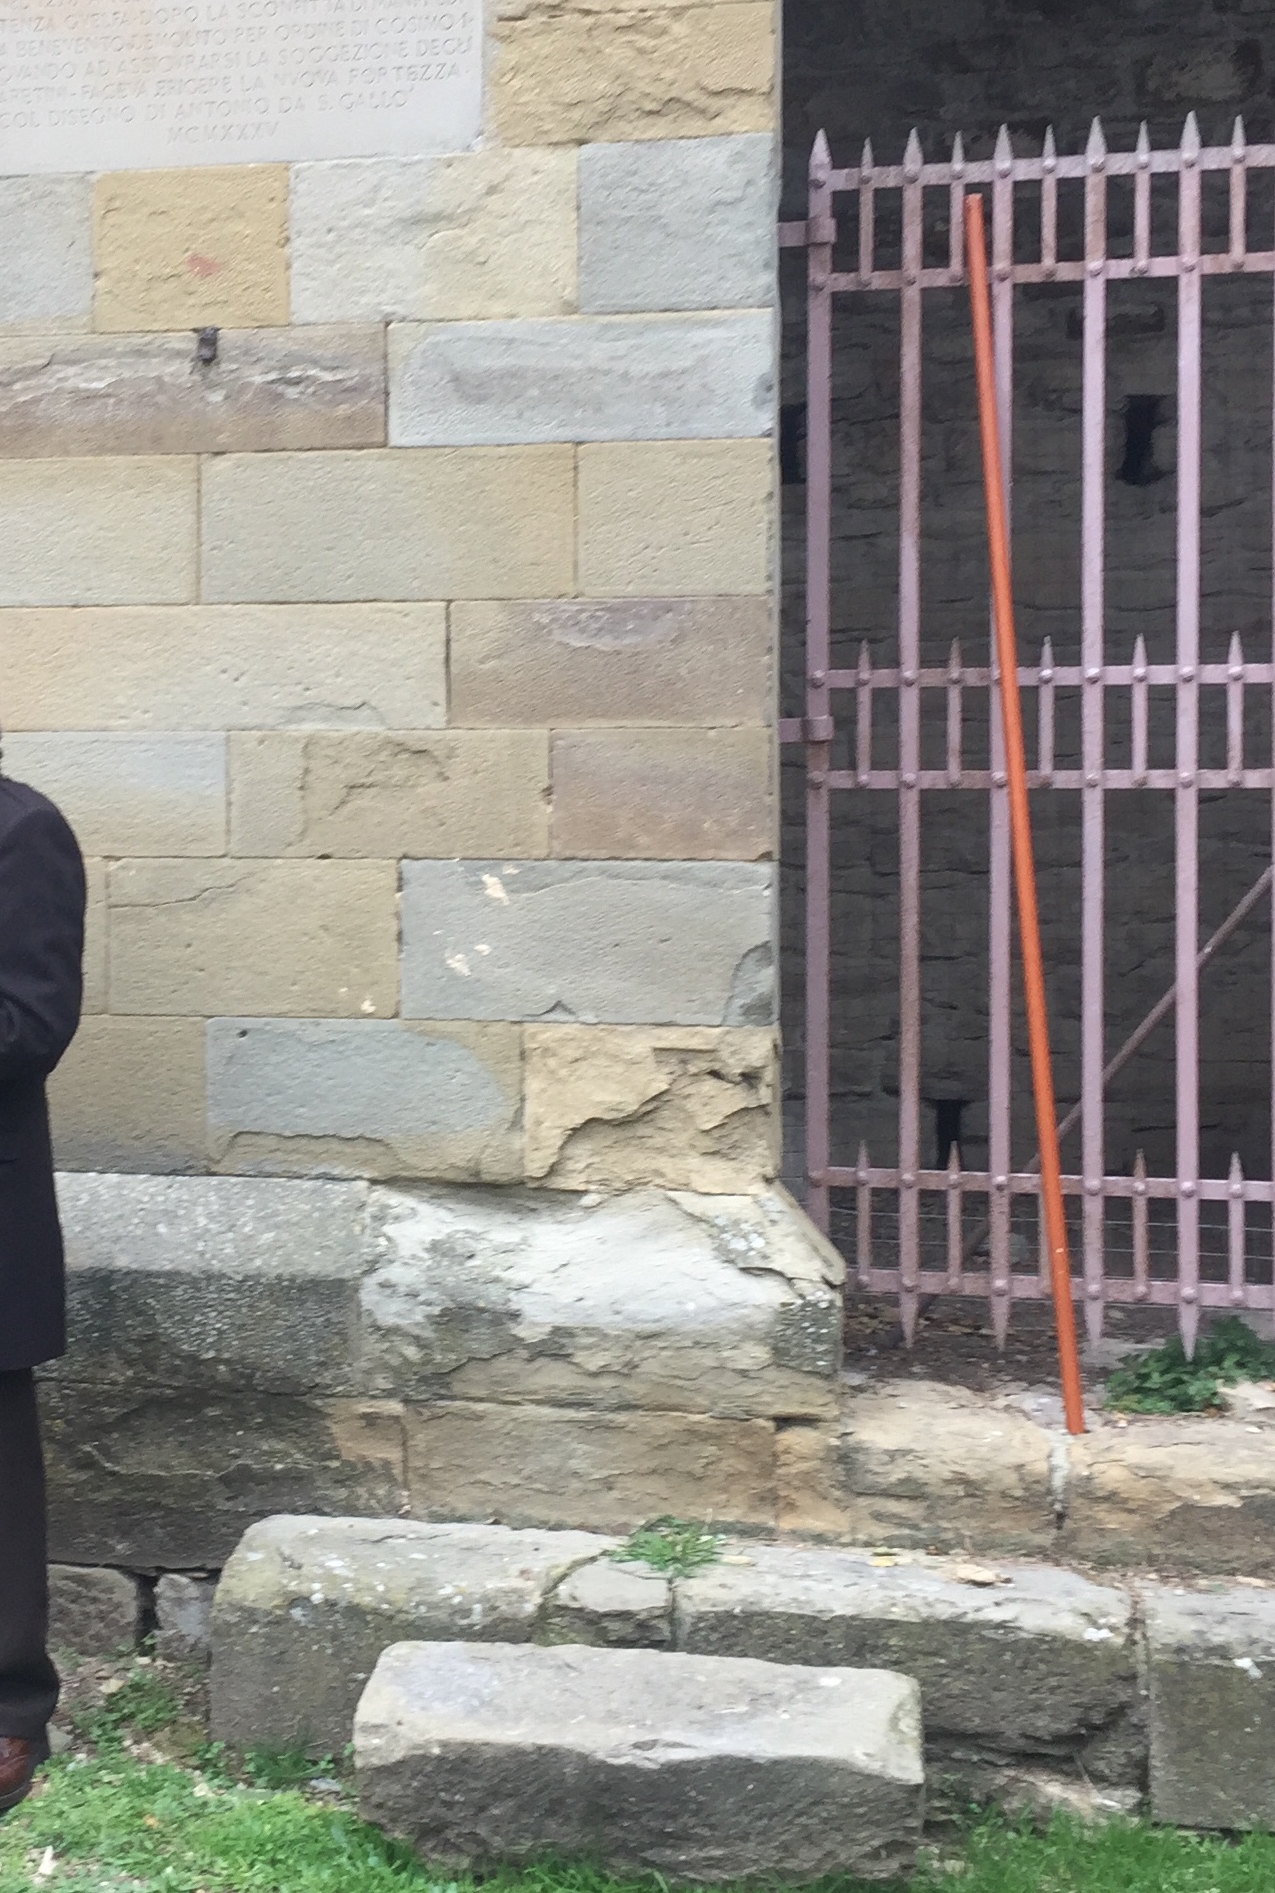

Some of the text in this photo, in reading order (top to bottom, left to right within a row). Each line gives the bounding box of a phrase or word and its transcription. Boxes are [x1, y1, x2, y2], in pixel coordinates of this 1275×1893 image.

[206, 4, 228, 22] LA
[234, 25, 267, 44] PER
[274, 20, 345, 41] ORDINE
[351, 19, 369, 37] DI
[375, 13, 455, 35] COSIMO
[84, 59, 110, 77] AD
[247, 50, 269, 68] LA
[278, 40, 408, 66] SOGGEZIONE
[240, 74, 266, 93] LA
[48, 105, 136, 127] DISEGNO
[145, 102, 166, 121] DI
[175, 97, 269, 119] ANTONIO
[278, 96, 306, 114] DA
